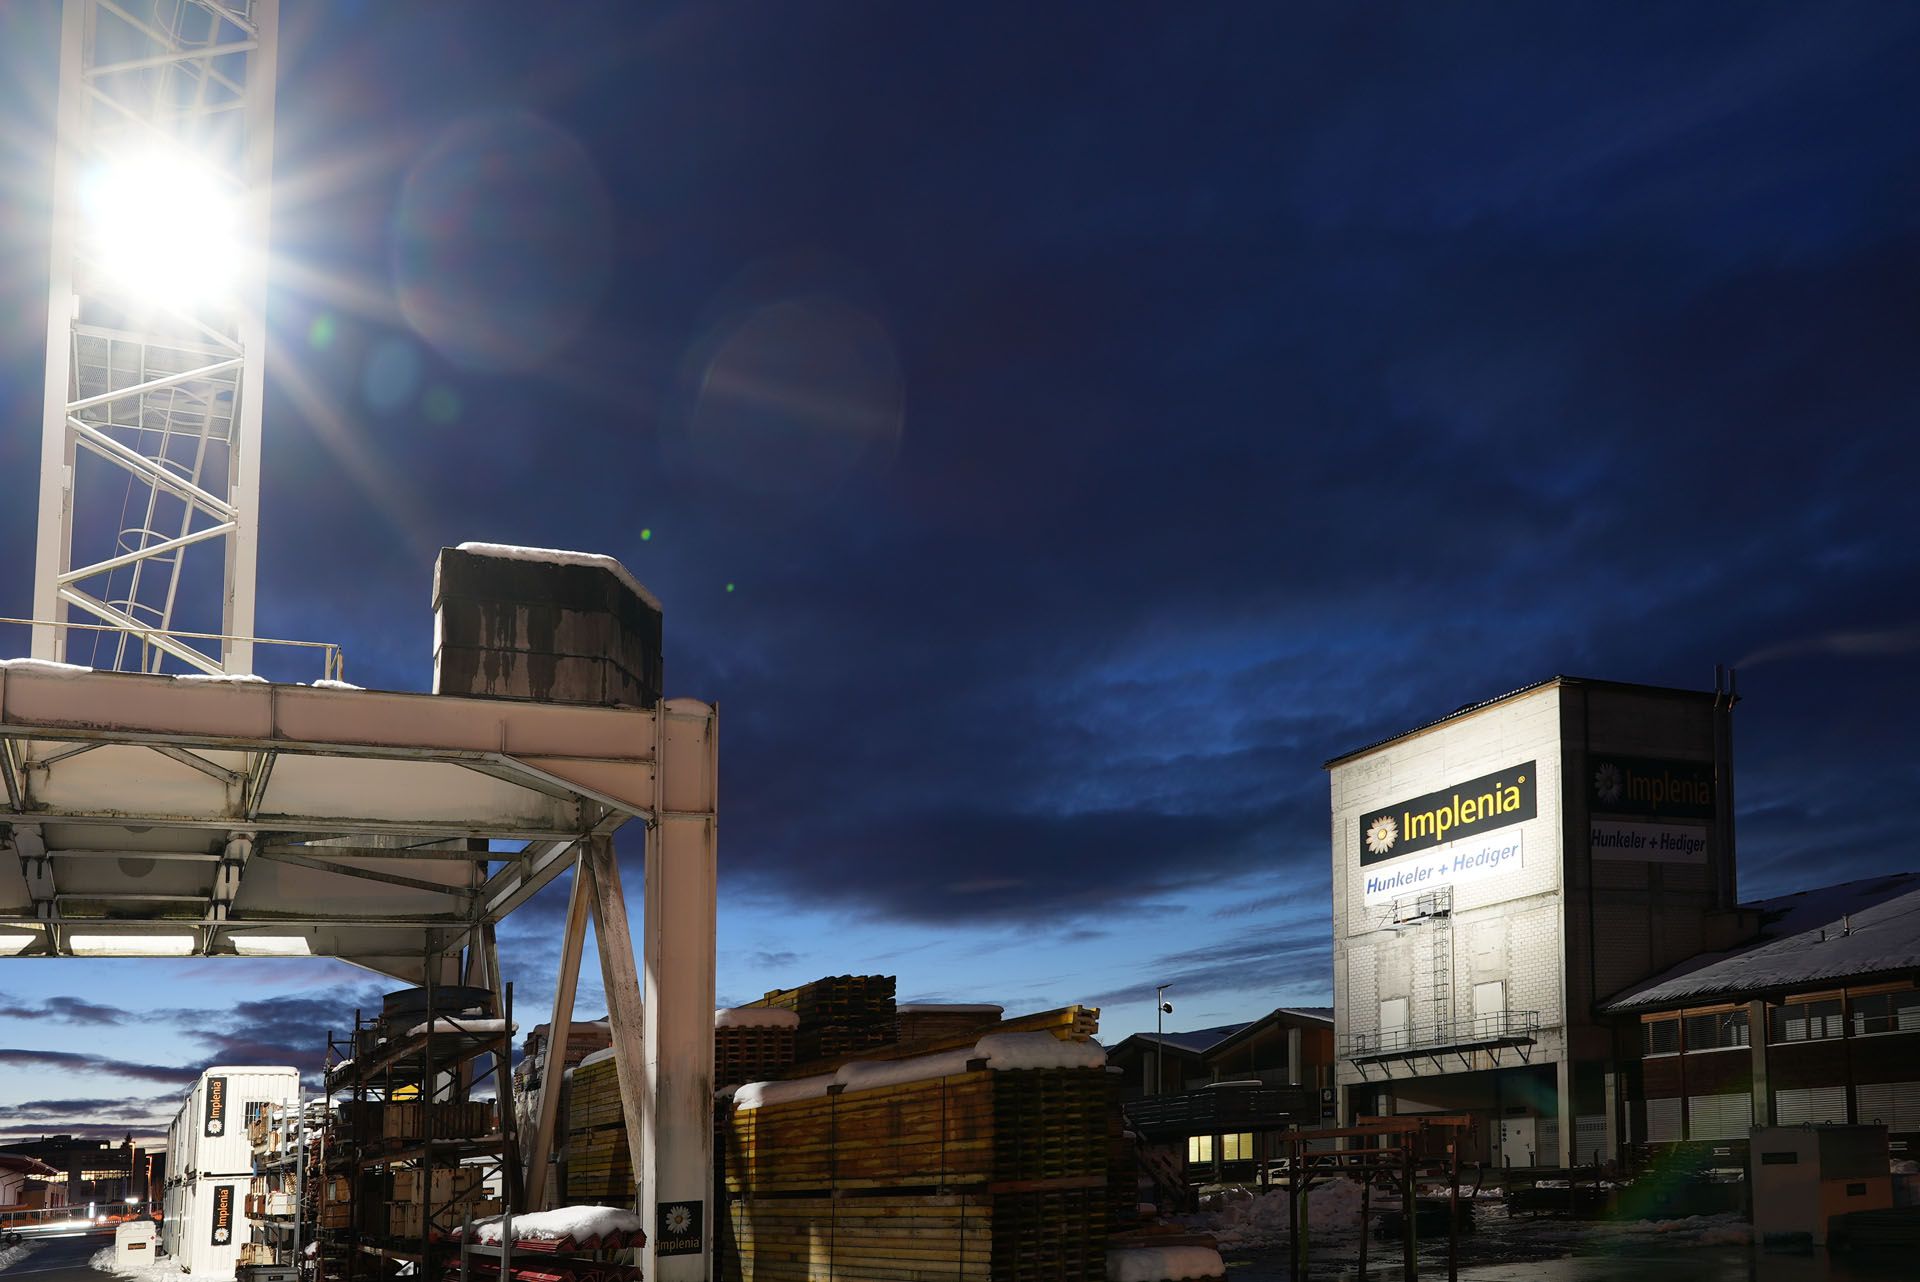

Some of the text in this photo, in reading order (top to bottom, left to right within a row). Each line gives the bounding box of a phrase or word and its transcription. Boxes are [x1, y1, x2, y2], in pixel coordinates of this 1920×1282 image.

[1626, 767, 1711, 810] Implenia
[1403, 781, 1521, 842] Implenia
[1592, 828, 1705, 855] Hunkeler + Hediger
[1366, 843, 1519, 895] Hunkeler + Hediger
[210, 1080, 223, 1119] Implenia
[217, 1188, 230, 1227] Implenia
[656, 1236, 700, 1253] Implenia
